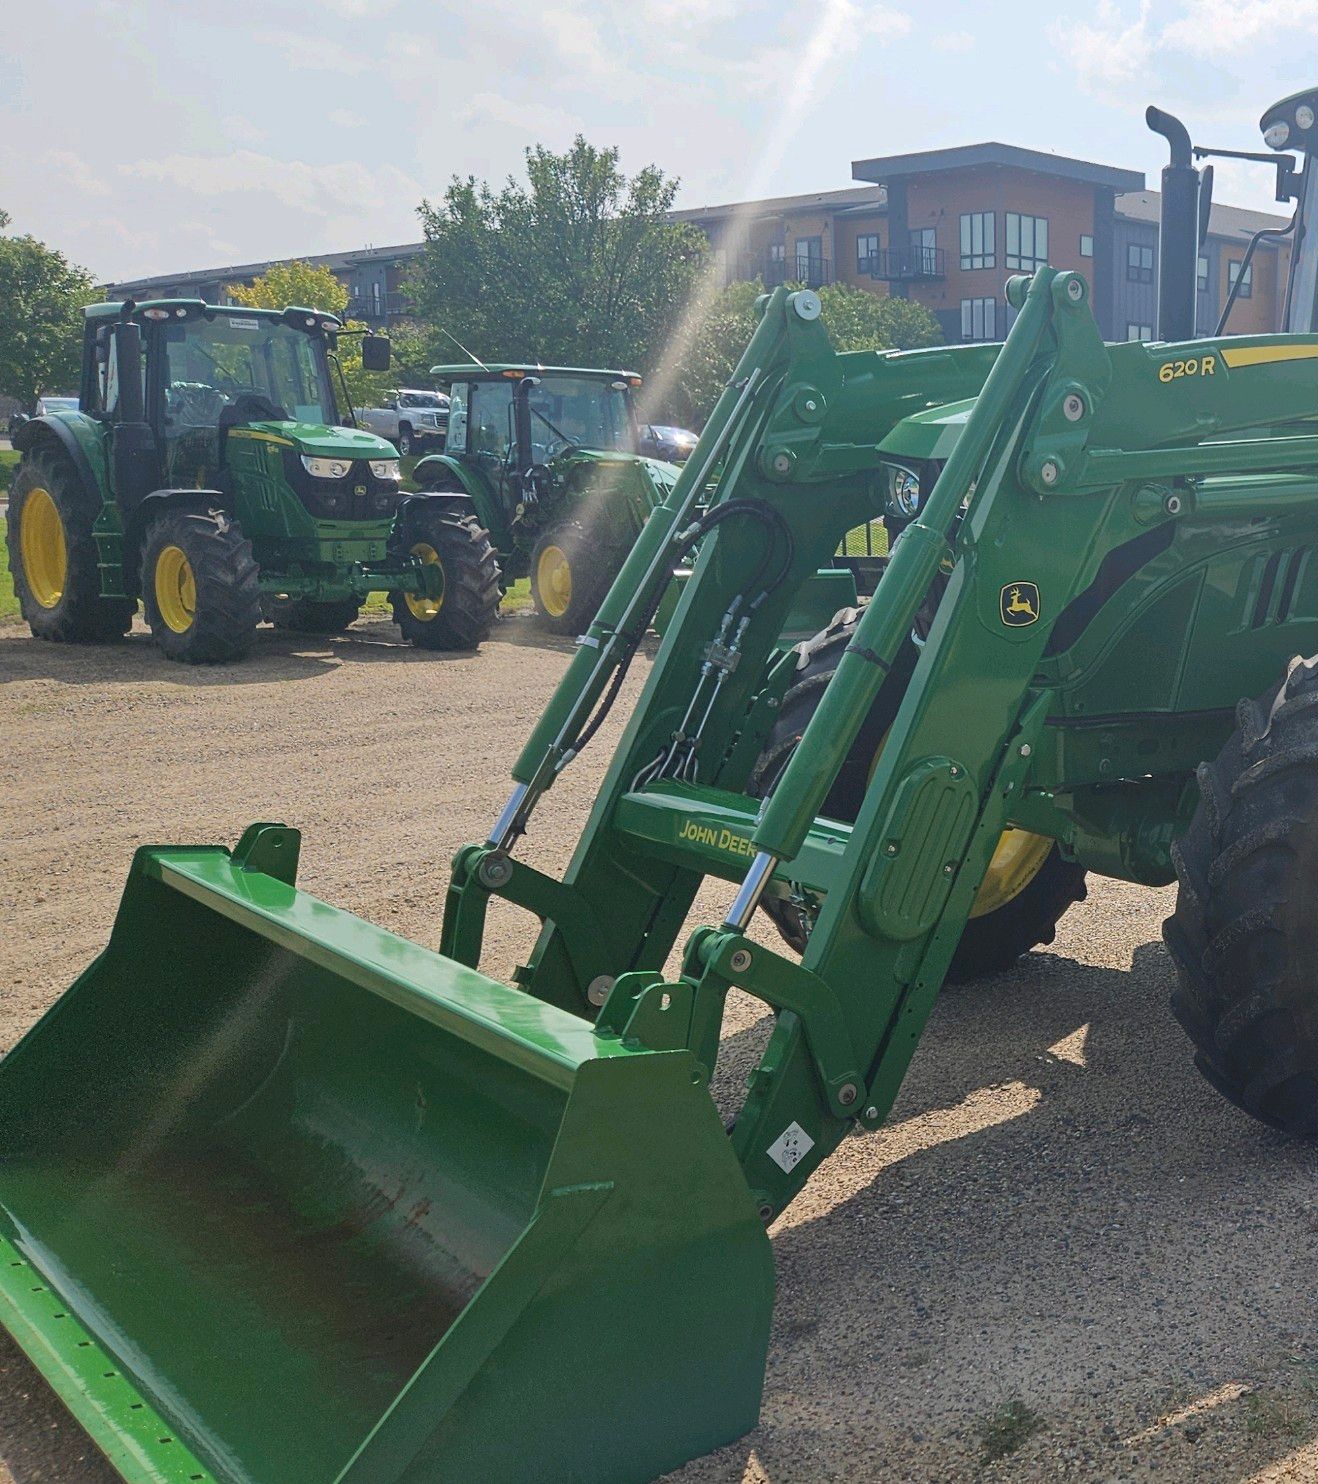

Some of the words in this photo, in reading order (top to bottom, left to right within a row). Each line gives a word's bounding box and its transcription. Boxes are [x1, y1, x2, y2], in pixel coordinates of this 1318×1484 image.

[1159, 359, 1198, 383] 620
[1201, 356, 1215, 376] R
[679, 820, 718, 846] JOHN
[718, 829, 757, 858] DEER
